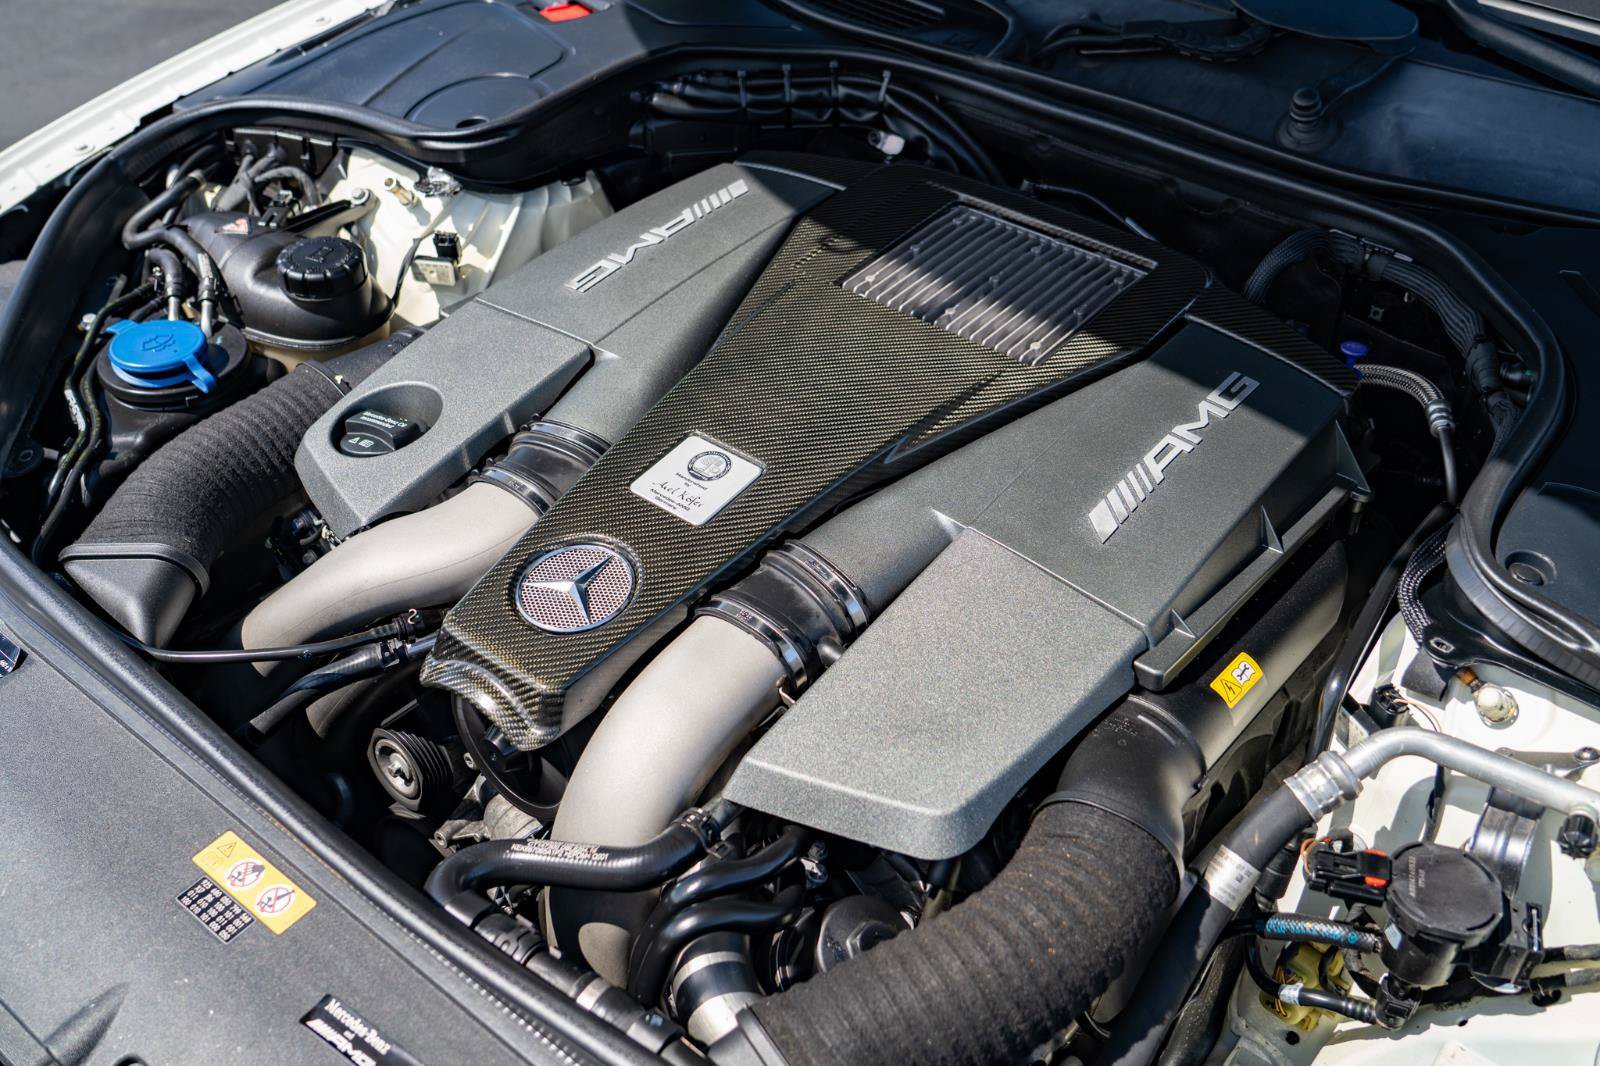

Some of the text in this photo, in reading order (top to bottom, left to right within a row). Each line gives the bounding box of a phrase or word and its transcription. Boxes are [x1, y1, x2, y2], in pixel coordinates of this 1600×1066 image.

[564, 207, 697, 293] AMG
[1143, 371, 1261, 485] AMG
[324, 998, 391, 1055] Mercedes-Benz
